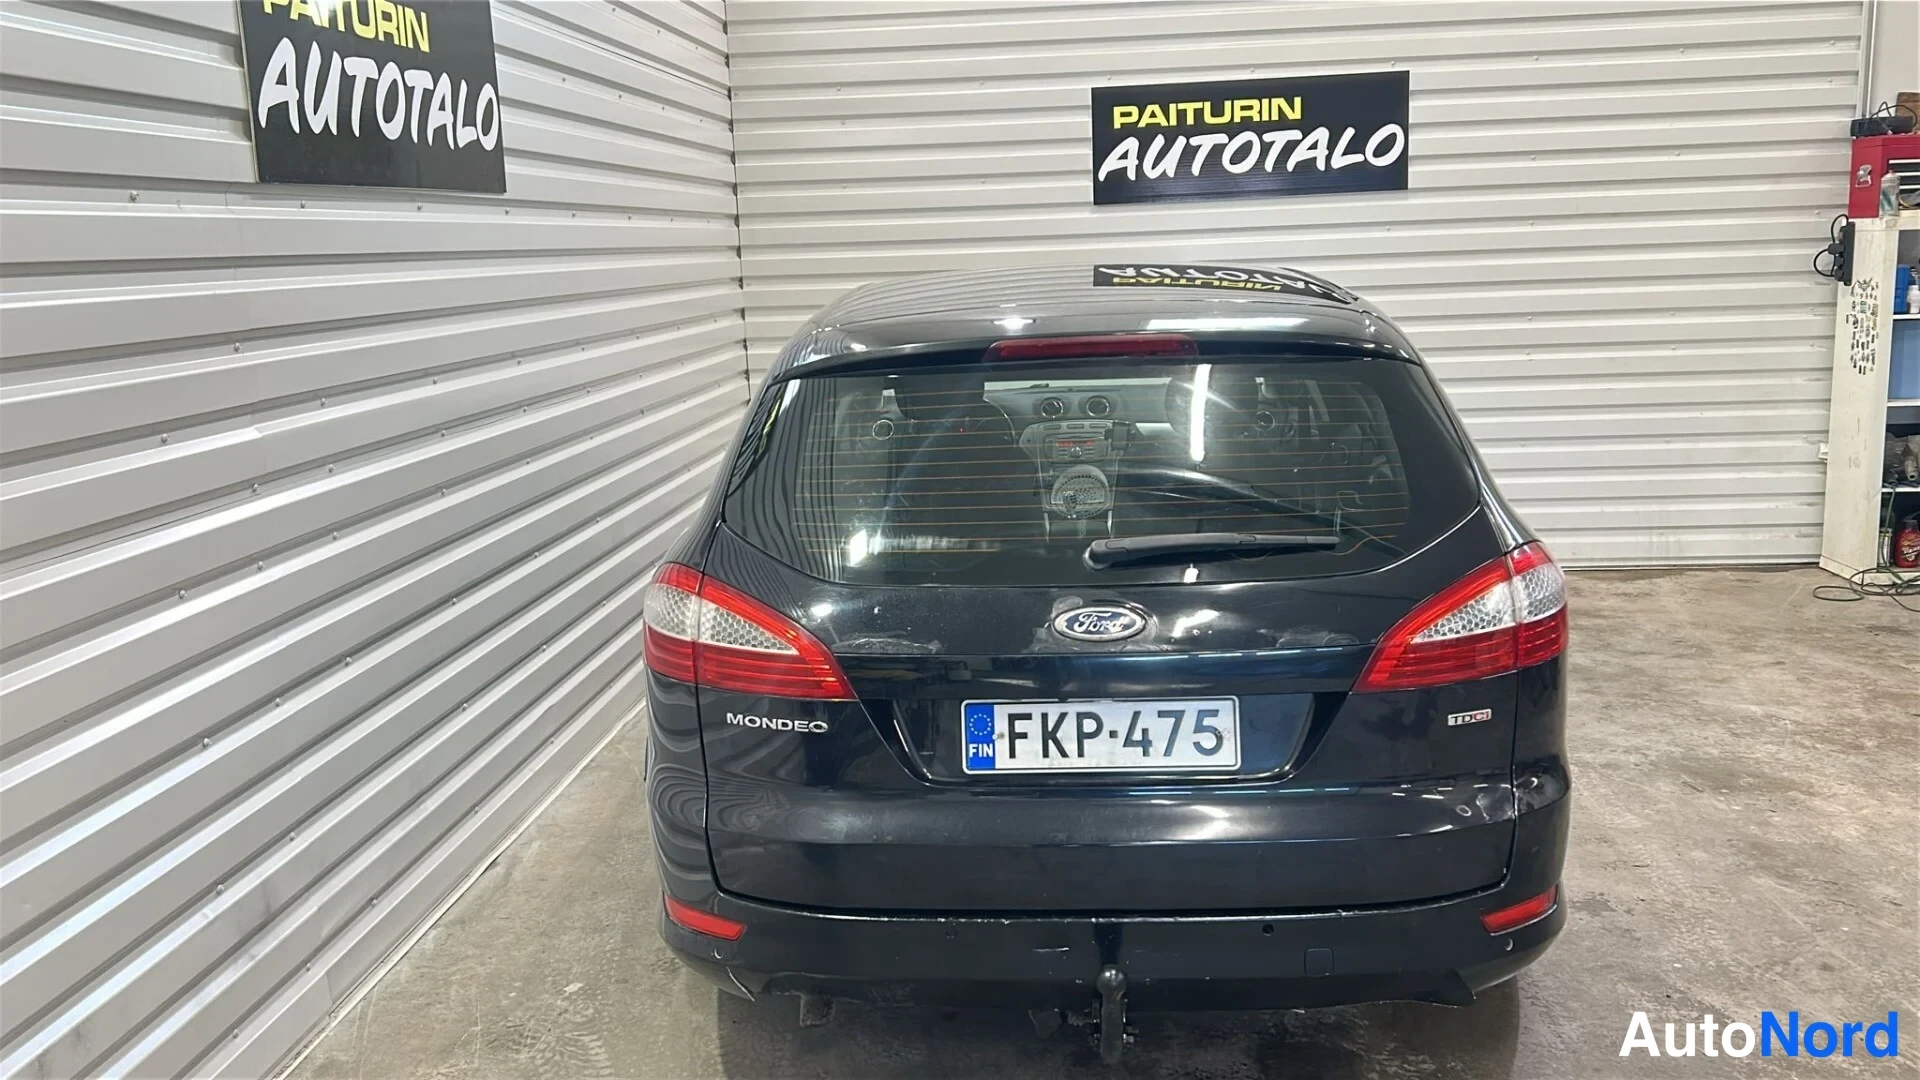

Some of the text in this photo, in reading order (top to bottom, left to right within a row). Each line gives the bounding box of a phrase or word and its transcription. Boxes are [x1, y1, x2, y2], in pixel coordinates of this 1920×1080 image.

[257, 37, 499, 151] AUTOTALO
[1113, 96, 1302, 129] PAITURIN
[1098, 123, 1406, 182] AUTOTALO
[1073, 612, 1130, 633] Ford
[726, 712, 829, 733] MONDEO
[968, 743, 994, 758] FIN
